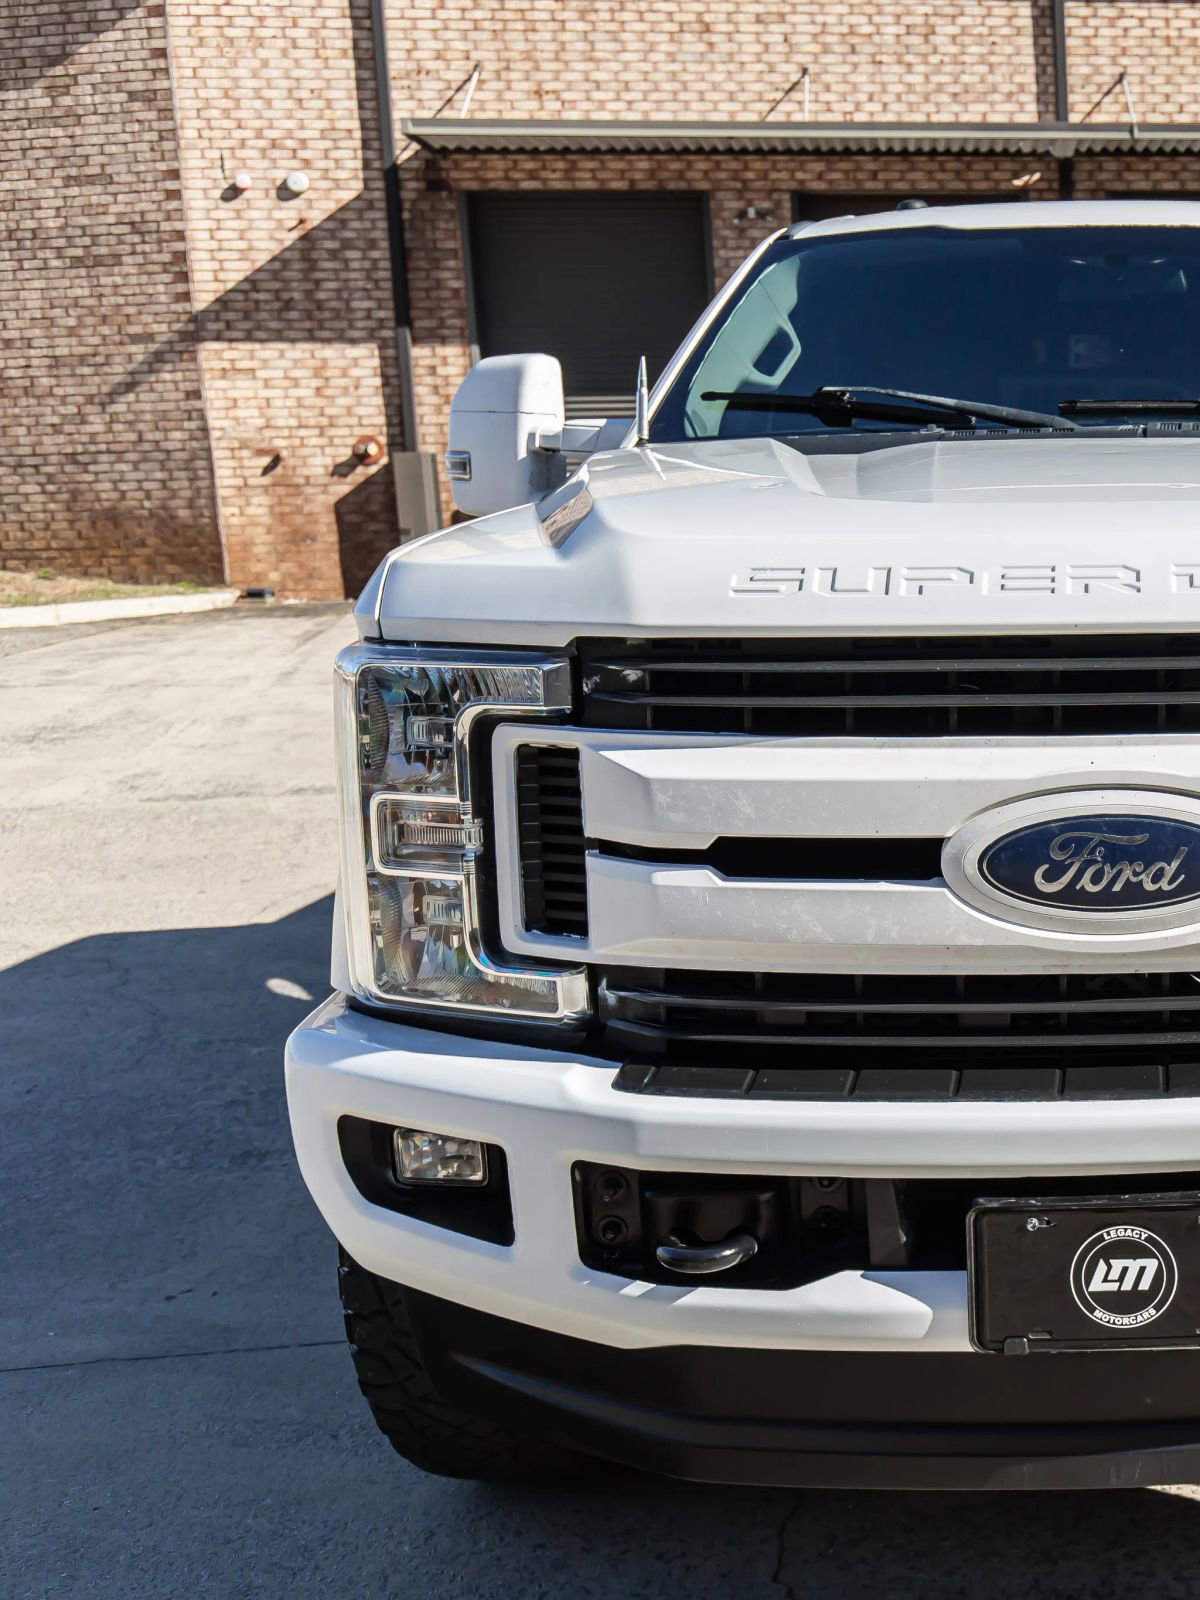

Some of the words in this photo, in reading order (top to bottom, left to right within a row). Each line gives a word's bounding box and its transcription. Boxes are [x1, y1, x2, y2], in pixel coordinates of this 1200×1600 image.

[728, 564, 1142, 597] SUPER
[1034, 831, 1188, 893] Ford
[1102, 1228, 1149, 1241] LEGACY
[1092, 1307, 1157, 1326] MOTORCARS
